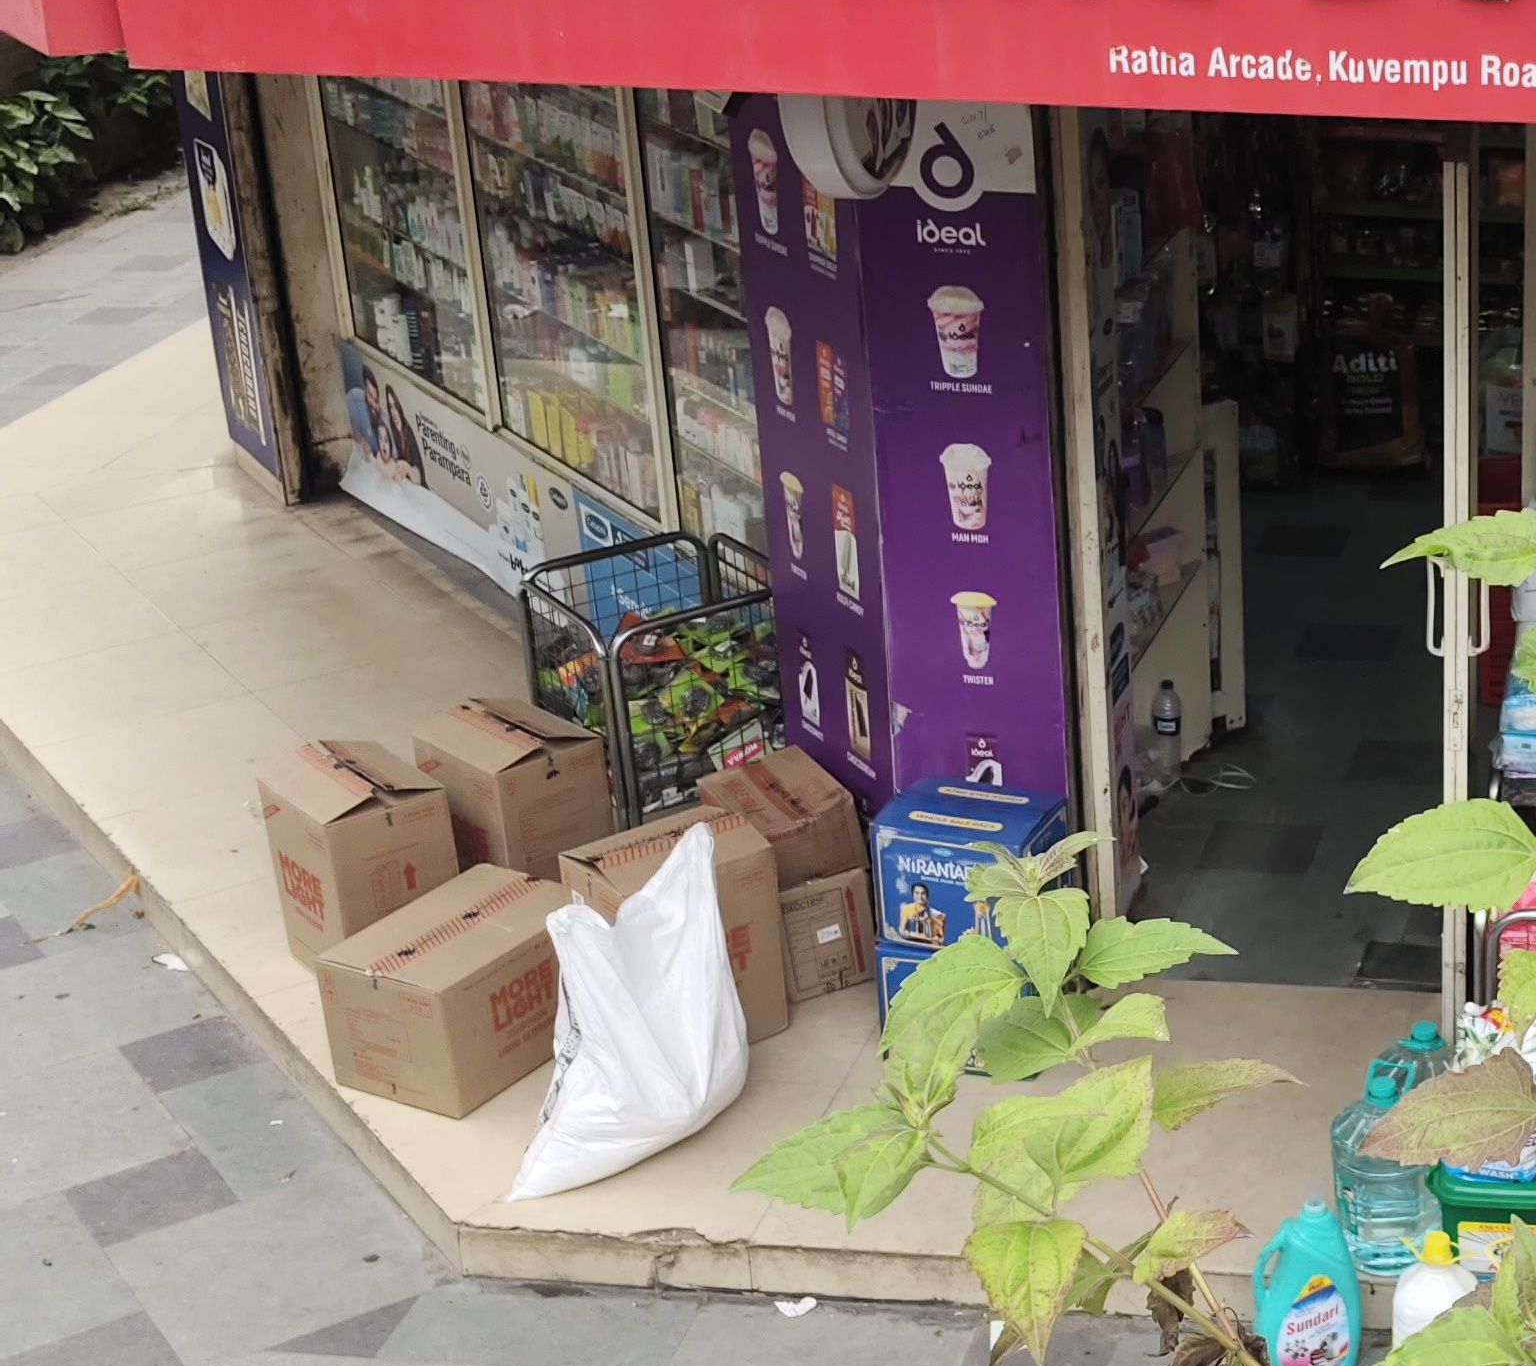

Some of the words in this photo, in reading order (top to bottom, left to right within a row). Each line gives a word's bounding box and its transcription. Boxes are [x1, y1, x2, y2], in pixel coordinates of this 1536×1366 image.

[1109, 45, 1196, 76] Ratna
[1207, 47, 1322, 87] Arcade,
[1328, 50, 1467, 91] Kuvempu
[916, 219, 986, 246] ideal
[1333, 349, 1398, 373] Aditi
[930, 381, 960, 392] TRIPPLE
[961, 382, 992, 394] SUNDAE
[414, 413, 457, 460] Parenting
[421, 437, 472, 487] Parampara
[951, 533, 970, 543] MAN
[962, 675, 994, 686] TWISTER
[490, 958, 554, 1012] MORE
[494, 982, 555, 1032] LIGHT
[1286, 1303, 1339, 1336] Sundari
